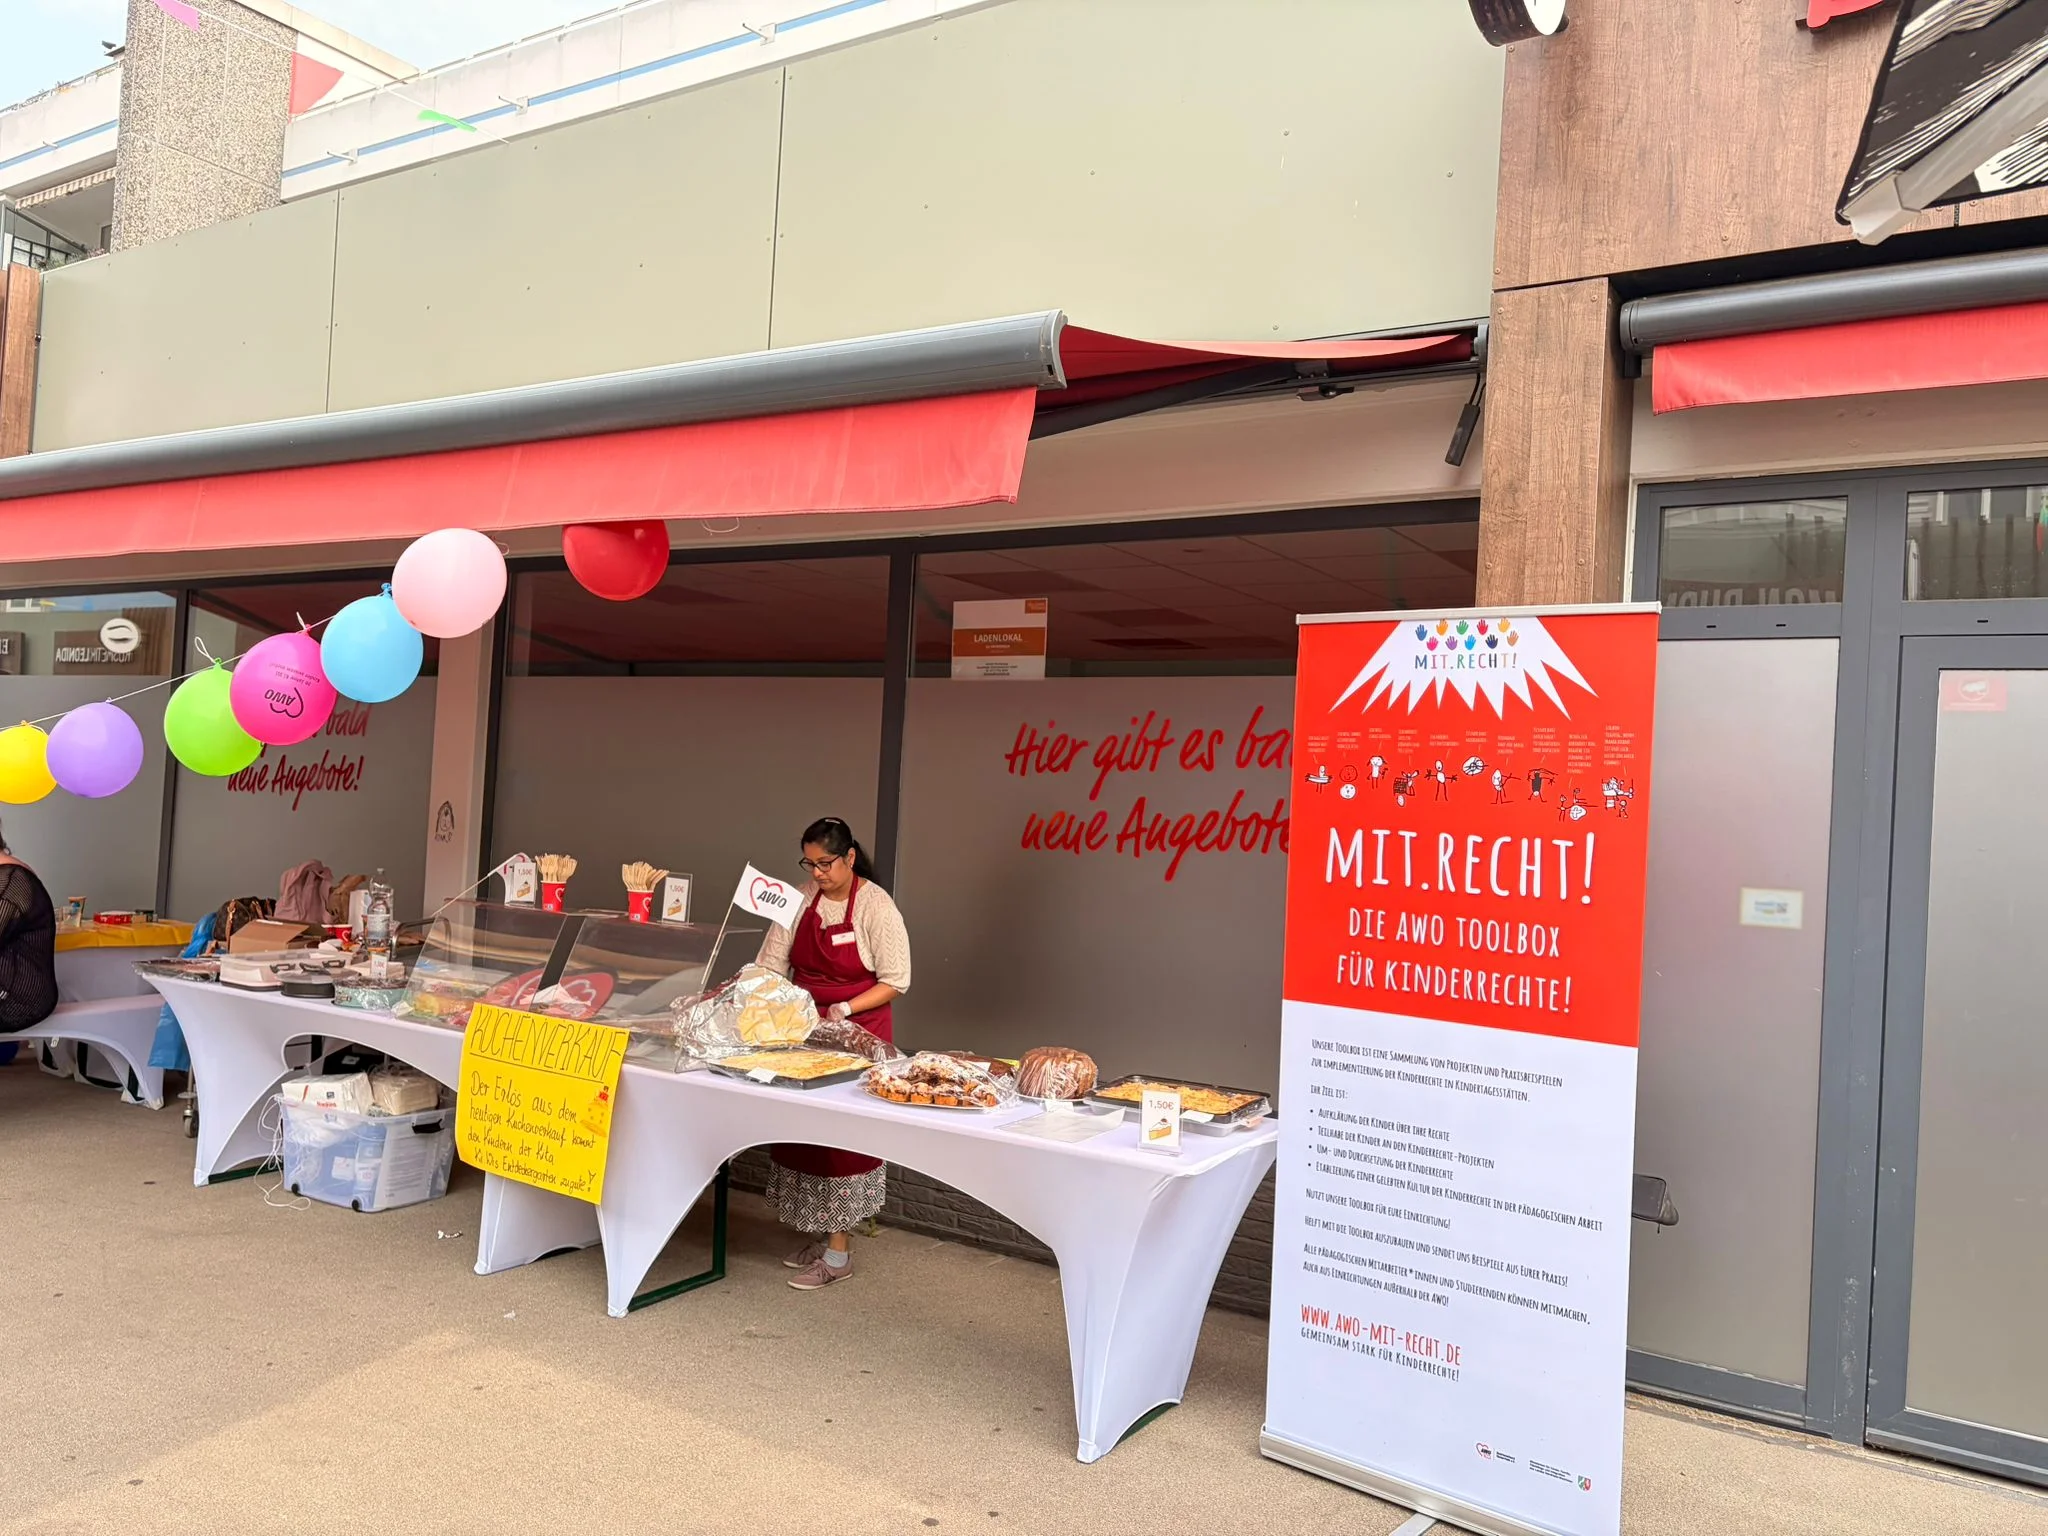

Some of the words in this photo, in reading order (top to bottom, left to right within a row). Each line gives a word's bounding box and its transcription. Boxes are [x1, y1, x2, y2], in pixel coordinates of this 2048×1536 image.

[974, 634, 1023, 642] LADENLOKAL
[1414, 653, 1517, 670] MIT.RECHT!
[264, 689, 296, 706] AWO
[1005, 720, 1088, 776] Hier
[1089, 710, 1175, 800] gibt
[1179, 728, 1224, 772] es
[1236, 706, 1293, 768] ba
[228, 764, 269, 794] neue
[271, 754, 364, 811] Angebote!
[1021, 810, 1108, 854] neue
[1325, 827, 1595, 904] MIT.RECHT!
[756, 890, 788, 909] AWO
[1350, 908, 1386, 940] DIE
[1396, 912, 1444, 946] AWO
[1456, 917, 1560, 958] TOOLBOX
[1337, 950, 1374, 988] FÜR
[1385, 960, 1572, 1013] KINDERRECHTE!
[470, 1006, 626, 1081] KUCHENVERKAUF
[1362, 1047, 1372, 1057] IST
[1373, 1048, 1391, 1060] EINE
[1390, 1050, 1428, 1066] SAMMLUNG
[1430, 1058, 1445, 1069] VON
[1484, 1066, 1500, 1077] UND
[470, 1071, 490, 1096] Der
[494, 1076, 522, 1108] Erlös
[532, 1096, 552, 1116] aus
[558, 1098, 577, 1124] dem
[1385, 1070, 1396, 1080] DER
[1444, 1079, 1454, 1089] IN
[470, 1098, 502, 1131] heutigen
[506, 1108, 566, 1148] Kuchenverkauf
[1148, 1100, 1174, 1111] 1,50€
[468, 1126, 481, 1143] den
[484, 1126, 512, 1154] Kindern
[518, 1139, 532, 1158] der
[536, 1142, 554, 1166] Kita
[1345, 1132, 1356, 1142] DER
[1357, 1133, 1380, 1147] KINDER
[1382, 1139, 1392, 1149] AN
[1393, 1141, 1406, 1152] DEN
[1359, 1116, 1370, 1125] DER
[1371, 1118, 1394, 1131] KINDER
[1428, 1128, 1450, 1142] RECHTE
[1334, 1148, 1348, 1158] UND
[1396, 1160, 1406, 1170] DER
[1357, 1171, 1375, 1183] EINER
[1407, 1180, 1430, 1194] KULTUR
[1432, 1186, 1443, 1197] DER
[1494, 1199, 1502, 1210] IN
[1504, 1201, 1516, 1213] DER
[1578, 1216, 1602, 1232] ARBEIT
[1322, 1220, 1334, 1232] MIT
[1336, 1224, 1346, 1234] DIE
[1416, 1242, 1430, 1254] UND
[1432, 1246, 1455, 1260] SENDET
[1456, 1250, 1470, 1264] UNS
[1506, 1263, 1518, 1275] AUS
[1520, 1265, 1540, 1280] EURER
[1320, 1266, 1330, 1276] AUS
[1418, 1290, 1430, 1302] DER
[1431, 1293, 1449, 1307] AWO!
[1440, 1276, 1454, 1289] UND
[1456, 1279, 1506, 1302] STUDIERENDEN
[1301, 1304, 1461, 1366] WWW.AWO-MIT-RECHT.DE
[1301, 1327, 1350, 1350] GEMEINSAM
[1352, 1340, 1376, 1357] STARK
[1378, 1348, 1393, 1362] FÜR
[1396, 1352, 1460, 1382] KINDERRECHTE!
